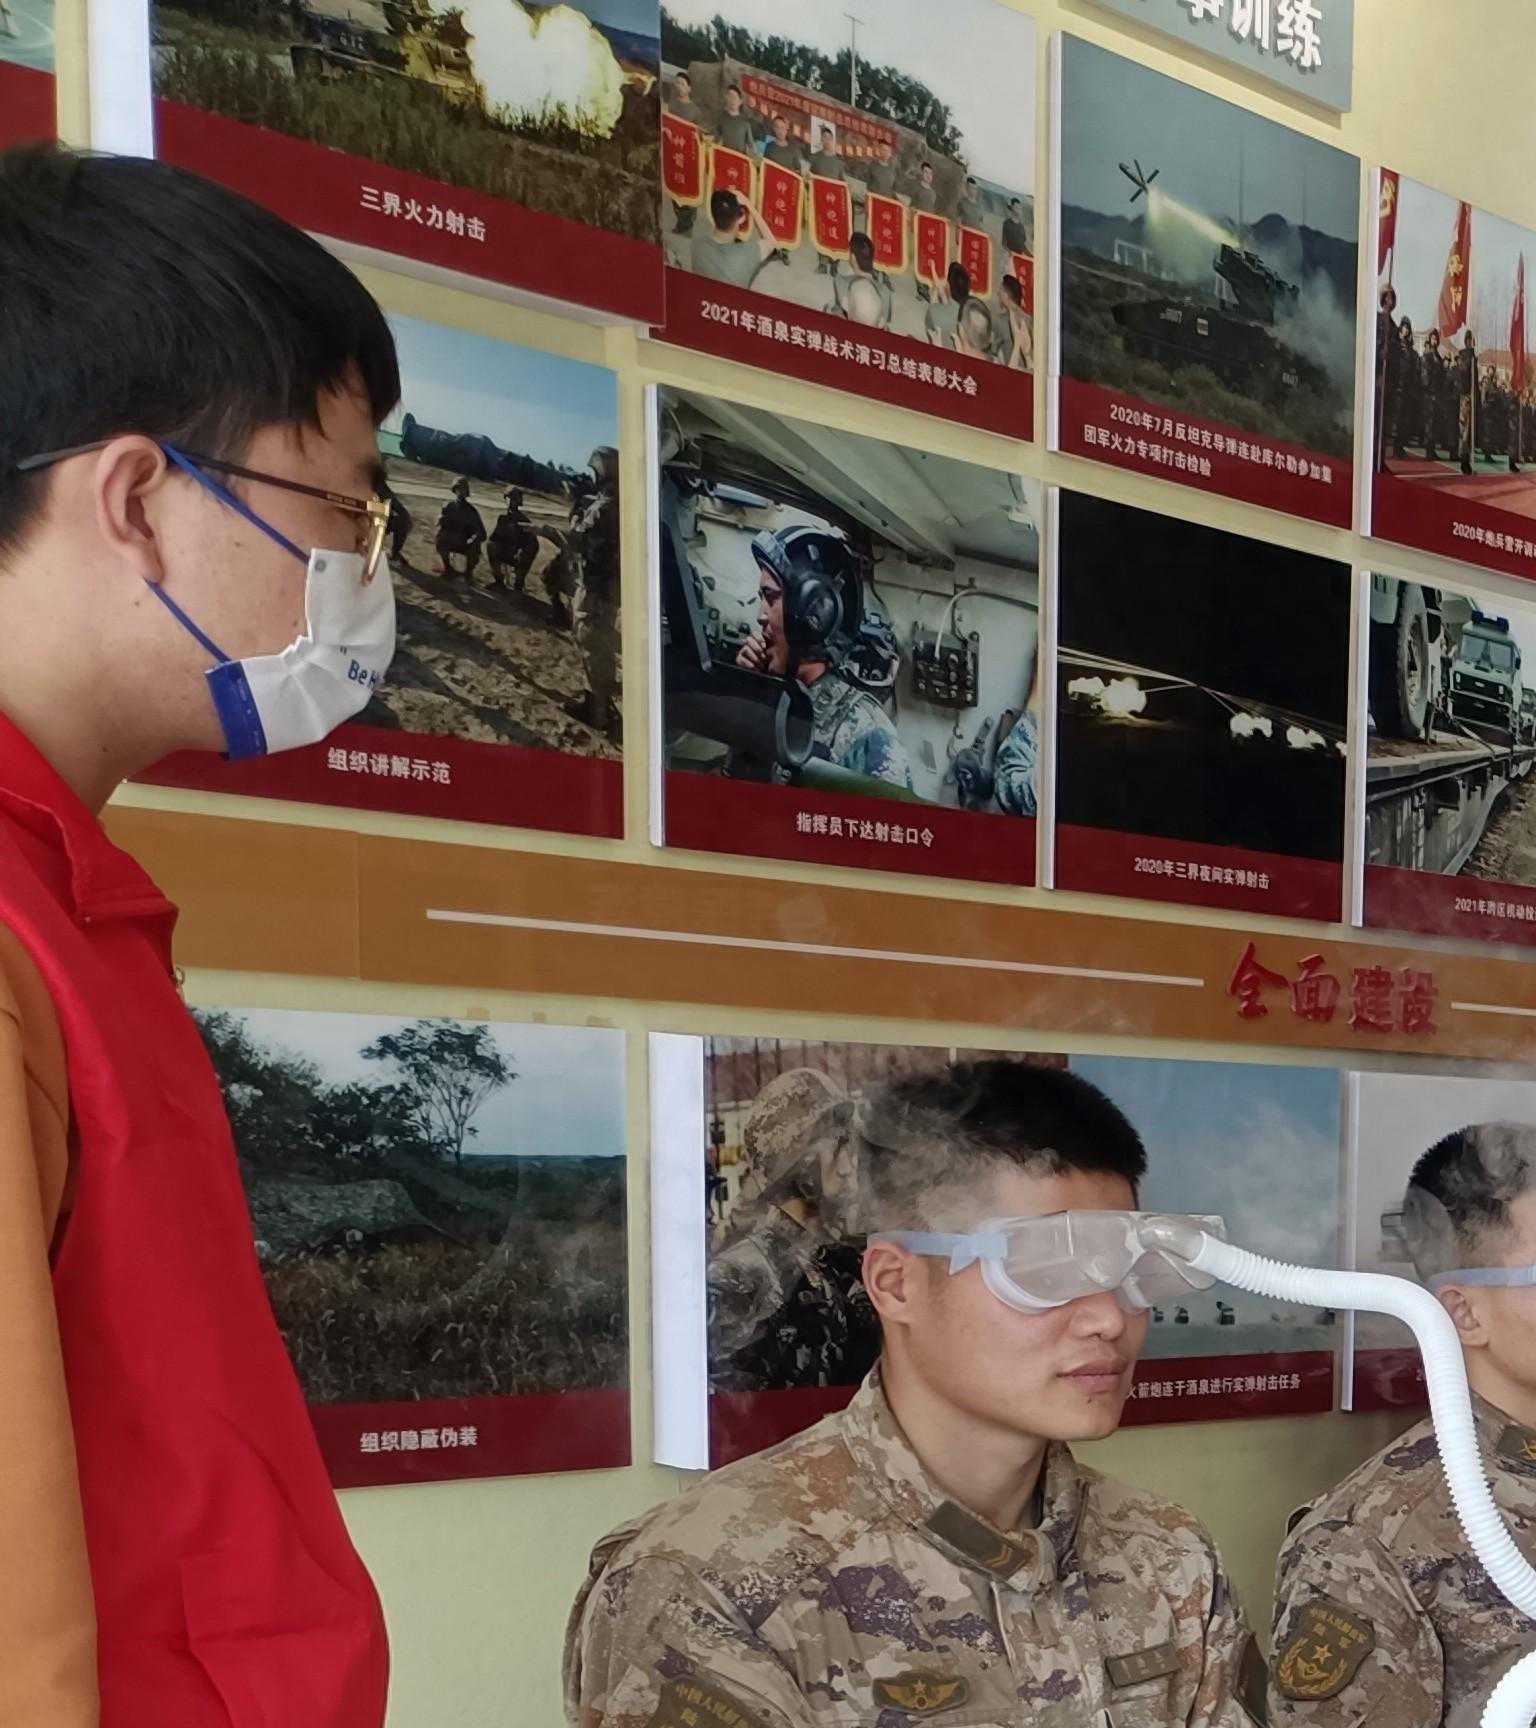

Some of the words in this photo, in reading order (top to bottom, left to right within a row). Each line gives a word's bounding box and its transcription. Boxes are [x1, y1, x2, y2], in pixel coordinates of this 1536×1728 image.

[1188, 0, 1322, 67] 训练
[360, 184, 485, 242] 三界火力射击
[1084, 423, 1212, 478] 团军火力专项打击检验
[348, 659, 368, 687] Be
[326, 746, 451, 785] 组织讲解示范
[796, 811, 935, 848] 指挥员下达射击口令
[1134, 856, 1270, 890] 2020年三界夜间实弹射击
[1225, 940, 1440, 1035] 全面建设
[359, 1425, 479, 1453] 组织隐蔽伪装
